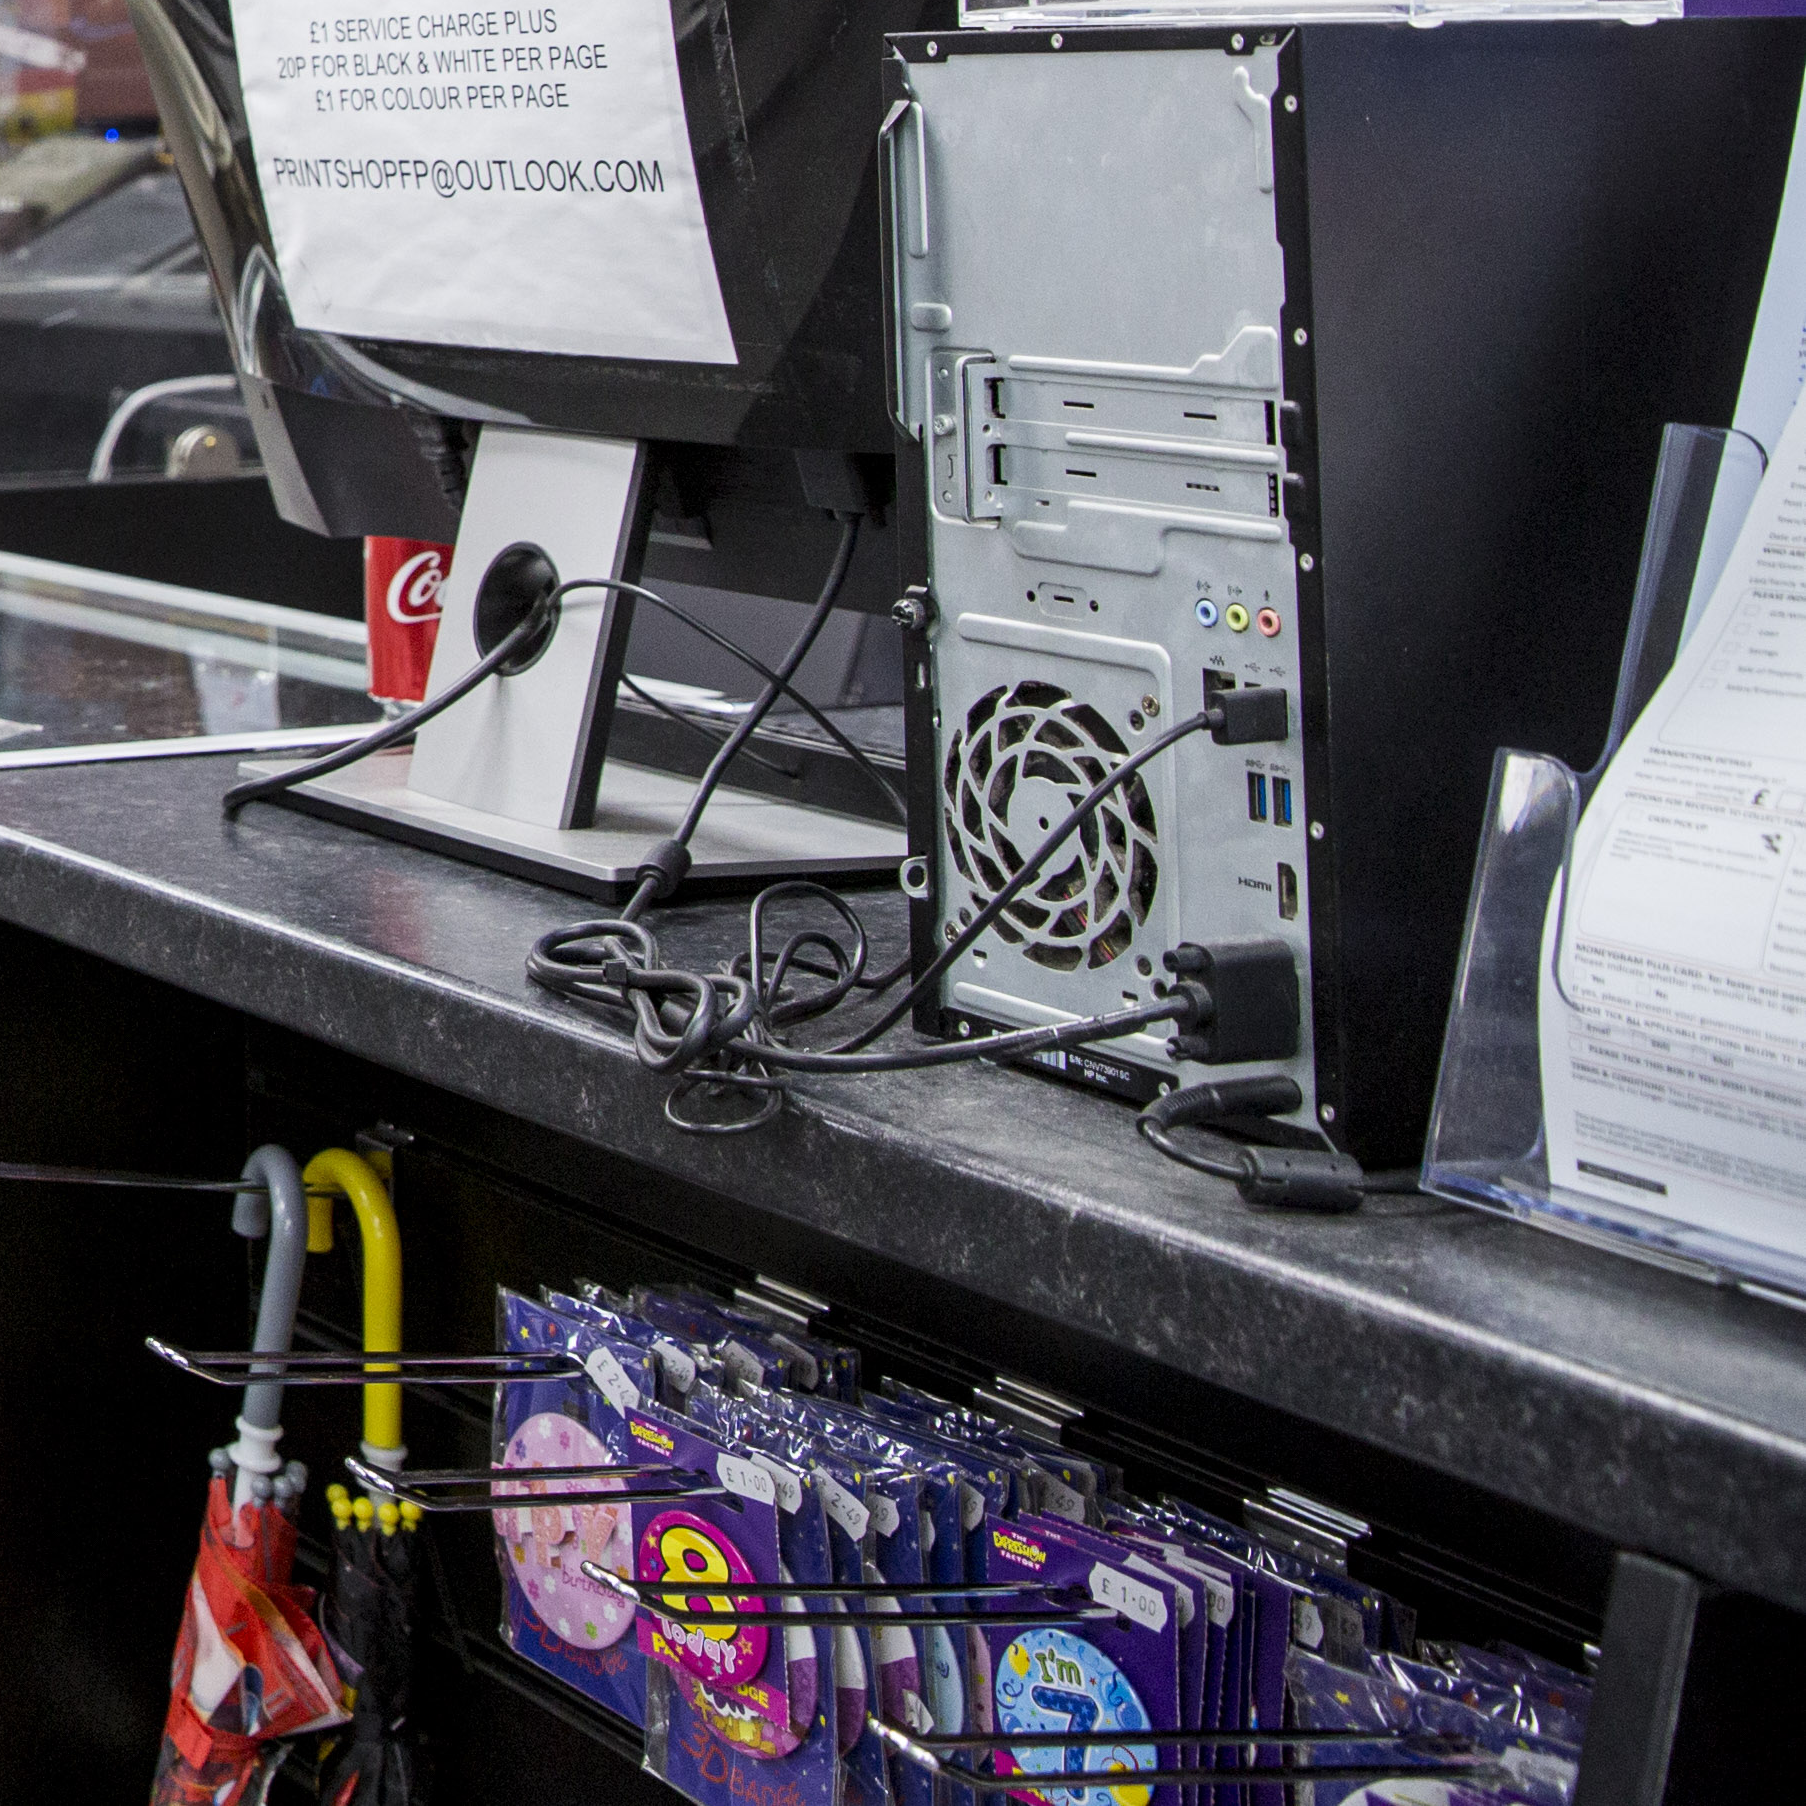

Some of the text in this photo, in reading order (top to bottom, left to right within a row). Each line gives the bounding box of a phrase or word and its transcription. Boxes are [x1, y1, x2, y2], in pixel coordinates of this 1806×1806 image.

[309, 8, 558, 44] £1 SERVICE CHARGE PLUS
[277, 44, 608, 80] 20P FOR BLACK & WHITE PER PAGE
[315, 83, 570, 113] £1 FOR COLOUR PER PAGE
[273, 157, 665, 198] PRINTSHOPFP@OUTLOOK.COM
[1238, 876, 1272, 893] HDMI
[659, 1524, 739, 1644] 8
[1034, 1647, 1083, 1686] I'm
